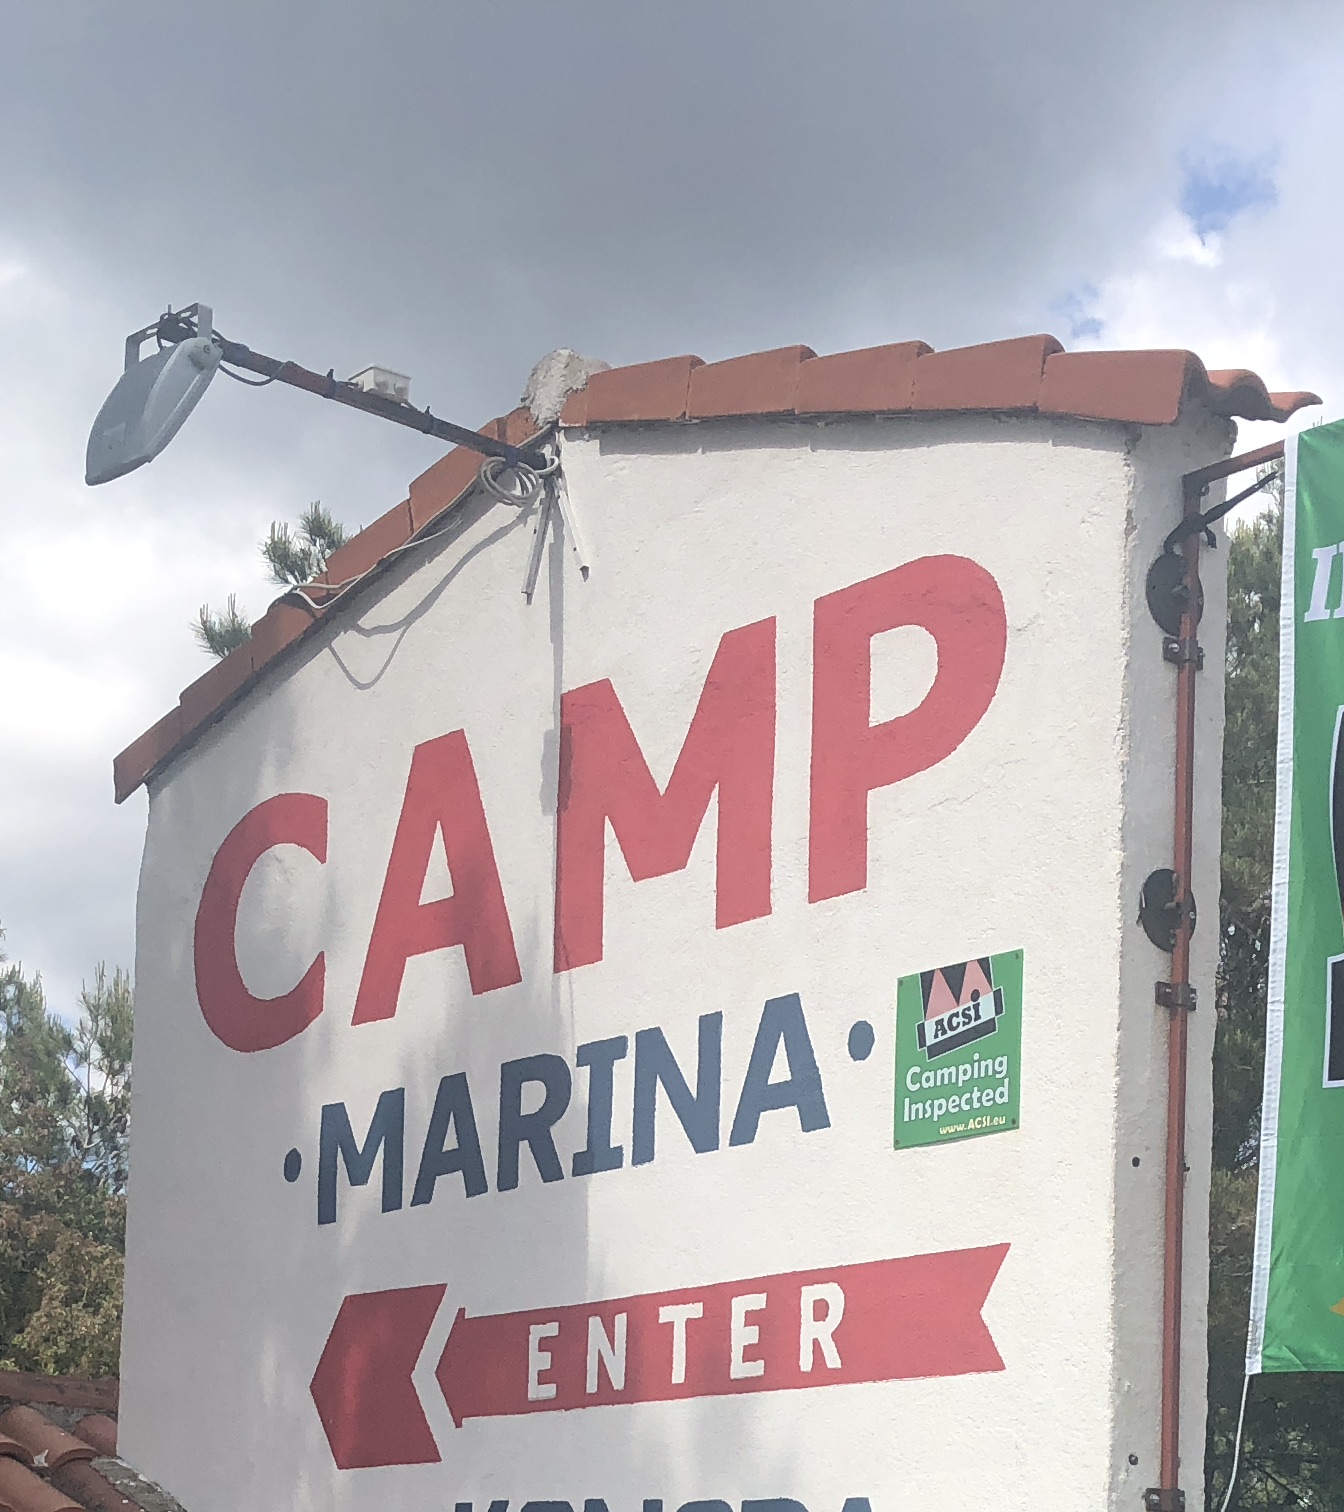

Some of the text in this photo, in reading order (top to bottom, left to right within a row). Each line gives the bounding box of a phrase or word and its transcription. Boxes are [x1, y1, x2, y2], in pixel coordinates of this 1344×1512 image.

[192, 553, 1008, 1054] CAMP
[905, 1052, 1008, 1092] Camping
[902, 1077, 1010, 1122] Inspected
[938, 1115, 1006, 1135] www.ACSI.eu
[527, 1282, 846, 1401] ENTER
